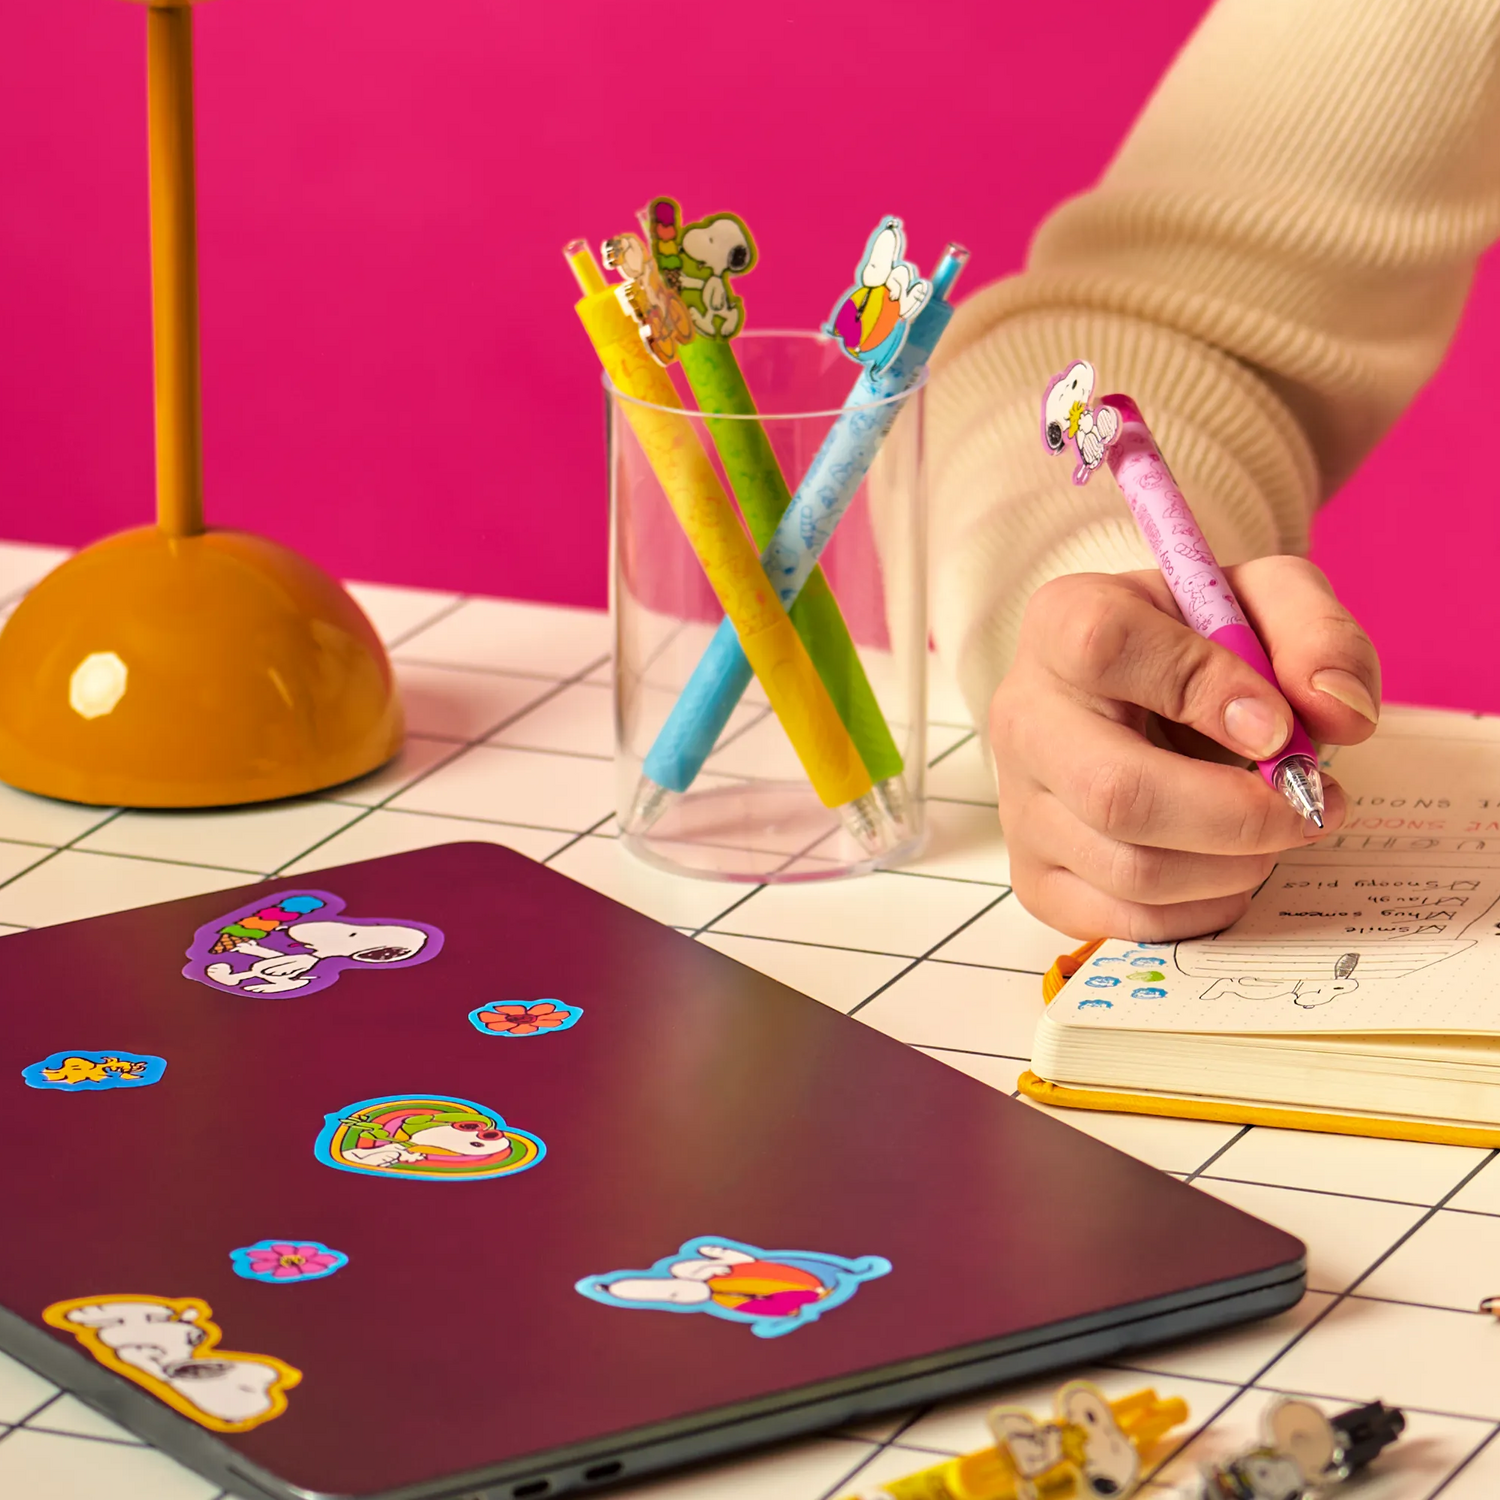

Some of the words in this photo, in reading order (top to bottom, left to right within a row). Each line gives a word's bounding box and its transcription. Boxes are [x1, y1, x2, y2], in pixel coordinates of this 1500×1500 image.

[1281, 879, 1339, 890] pics
[1367, 895, 1429, 906] laugh
[1278, 910, 1363, 919] someone
[1380, 909, 1420, 920] hug
[1343, 925, 1411, 935] smile
